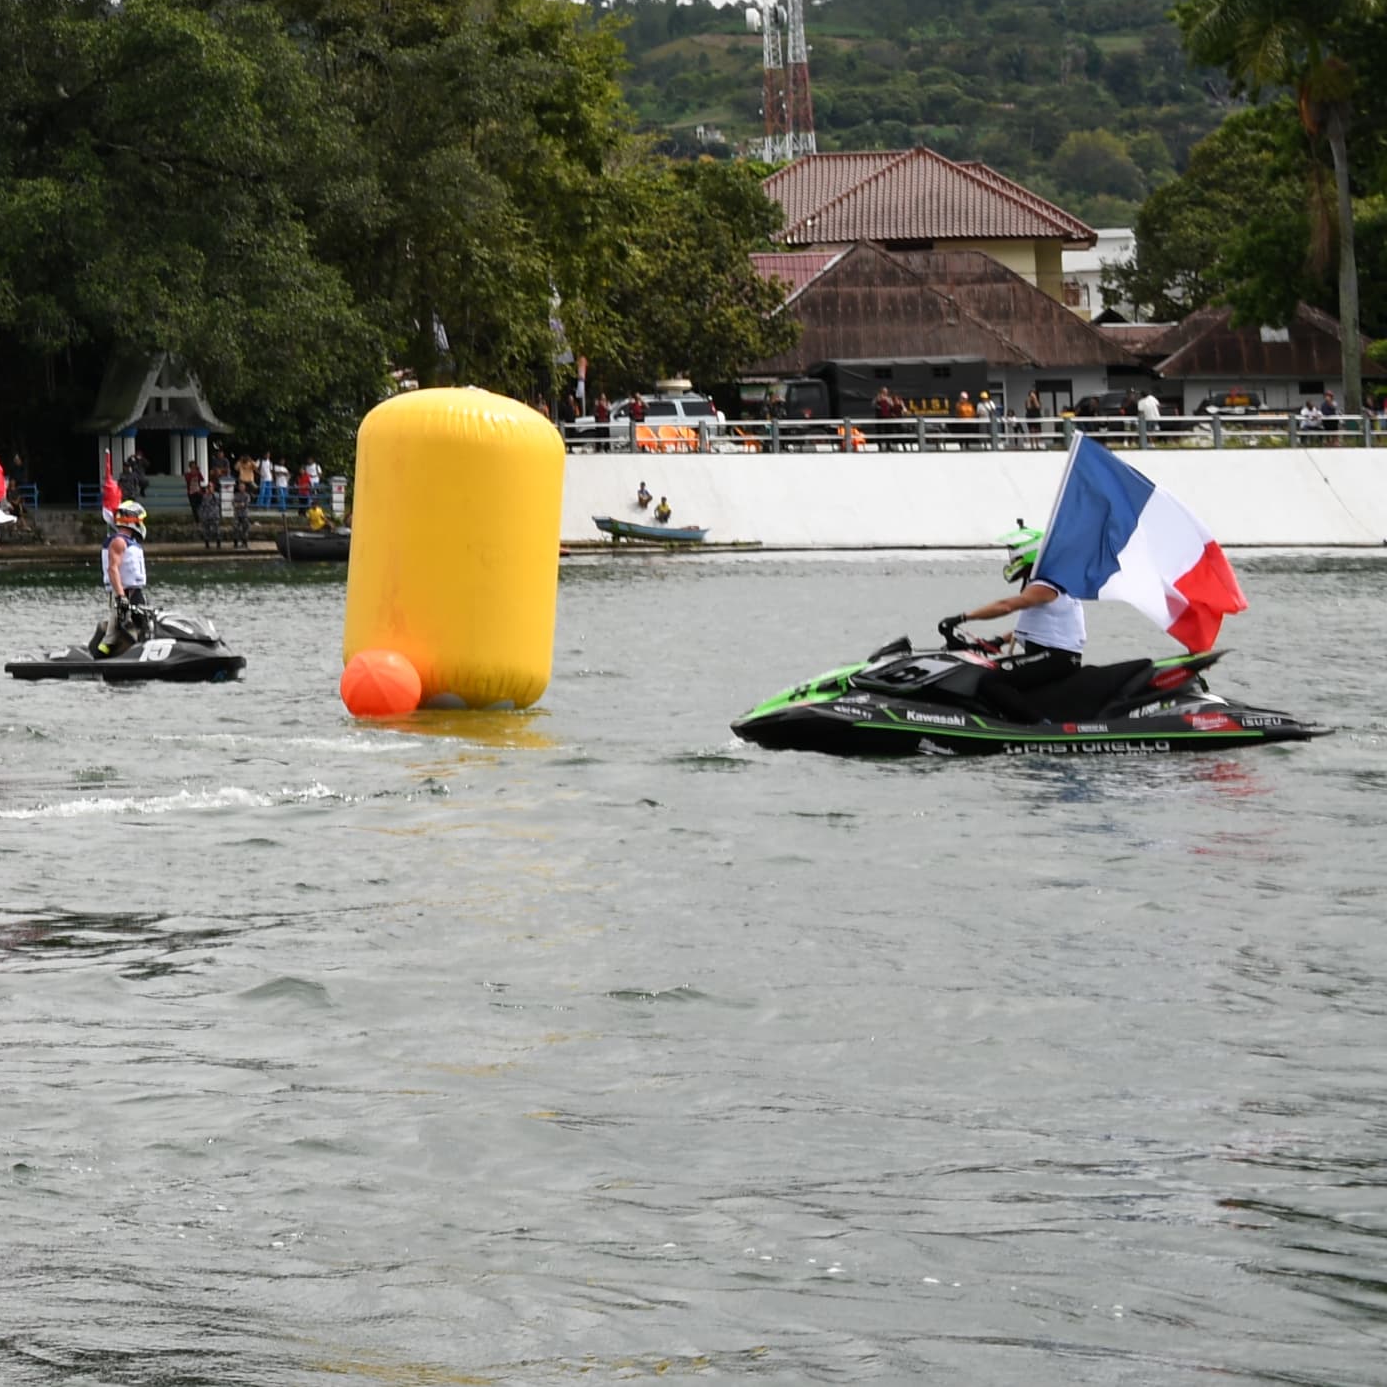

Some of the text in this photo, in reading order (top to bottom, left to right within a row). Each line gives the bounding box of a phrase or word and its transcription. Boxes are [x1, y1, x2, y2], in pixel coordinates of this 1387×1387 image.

[139, 638, 176, 663] 15
[906, 709, 966, 727] Kawasaki
[1241, 717, 1282, 727] ISUZU
